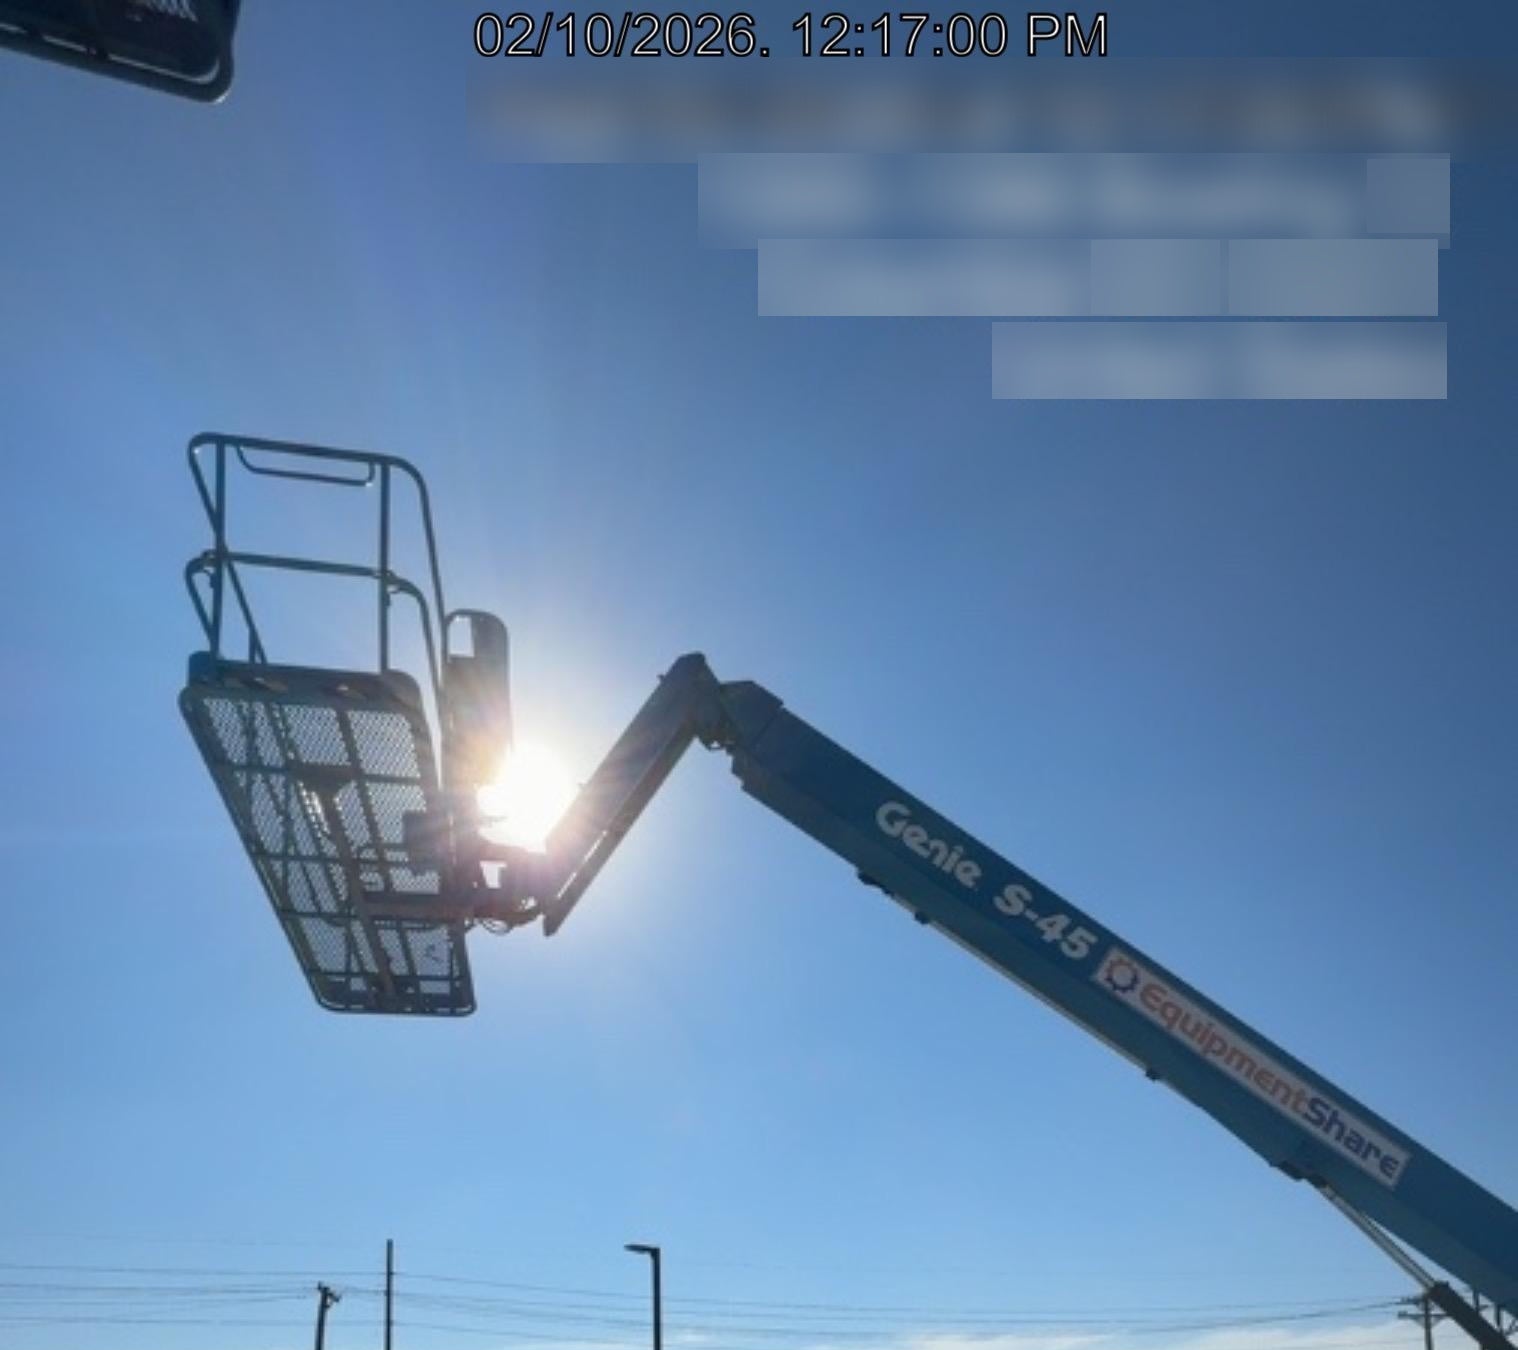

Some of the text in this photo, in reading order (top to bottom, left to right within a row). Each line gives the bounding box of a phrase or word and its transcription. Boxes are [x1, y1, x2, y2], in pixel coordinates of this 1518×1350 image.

[876, 801, 1098, 959] Genie S-45
[1139, 982, 1400, 1179] EquipmentShare
